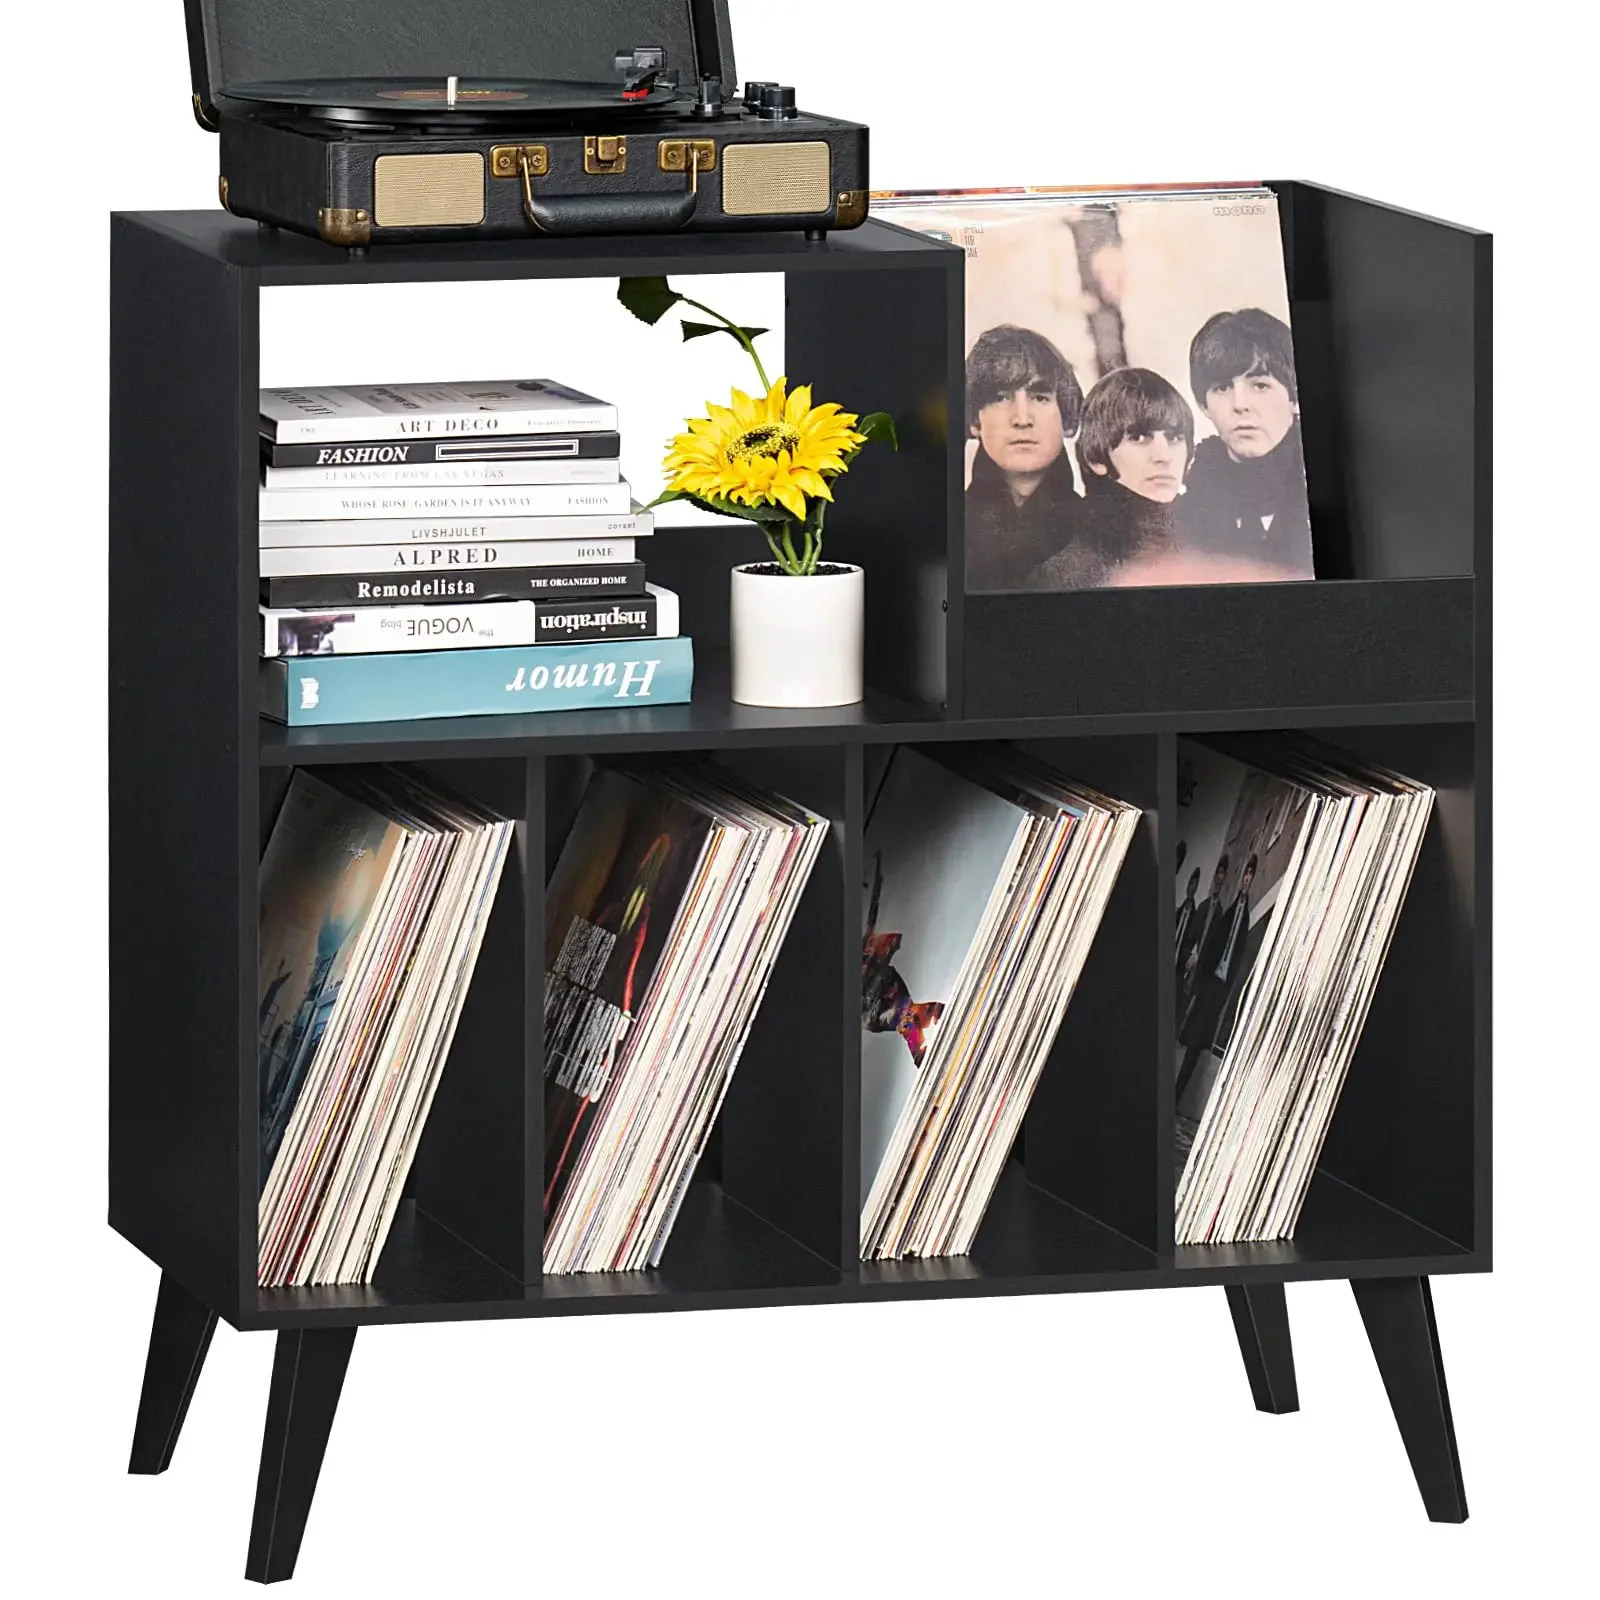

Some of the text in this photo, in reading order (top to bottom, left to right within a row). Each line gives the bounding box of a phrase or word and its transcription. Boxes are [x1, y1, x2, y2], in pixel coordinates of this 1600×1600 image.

[1212, 205, 1266, 216] mono
[396, 418, 499, 433] ART DECO
[316, 445, 410, 465] FASHION
[341, 497, 533, 509] WHOSE ROSE GARDEN IS IT ANYWAY
[568, 496, 609, 505] FASHION
[412, 526, 487, 539] LIVSHJULET
[393, 547, 498, 566] ALPRED
[577, 547, 614, 557] HOME
[357, 579, 475, 598] Remodelista
[530, 576, 627, 588] THE ORGANIZED HOME
[380, 617, 494, 638] the VOGUE blog
[540, 606, 648, 634] inspiration
[505, 660, 661, 698] Humor
